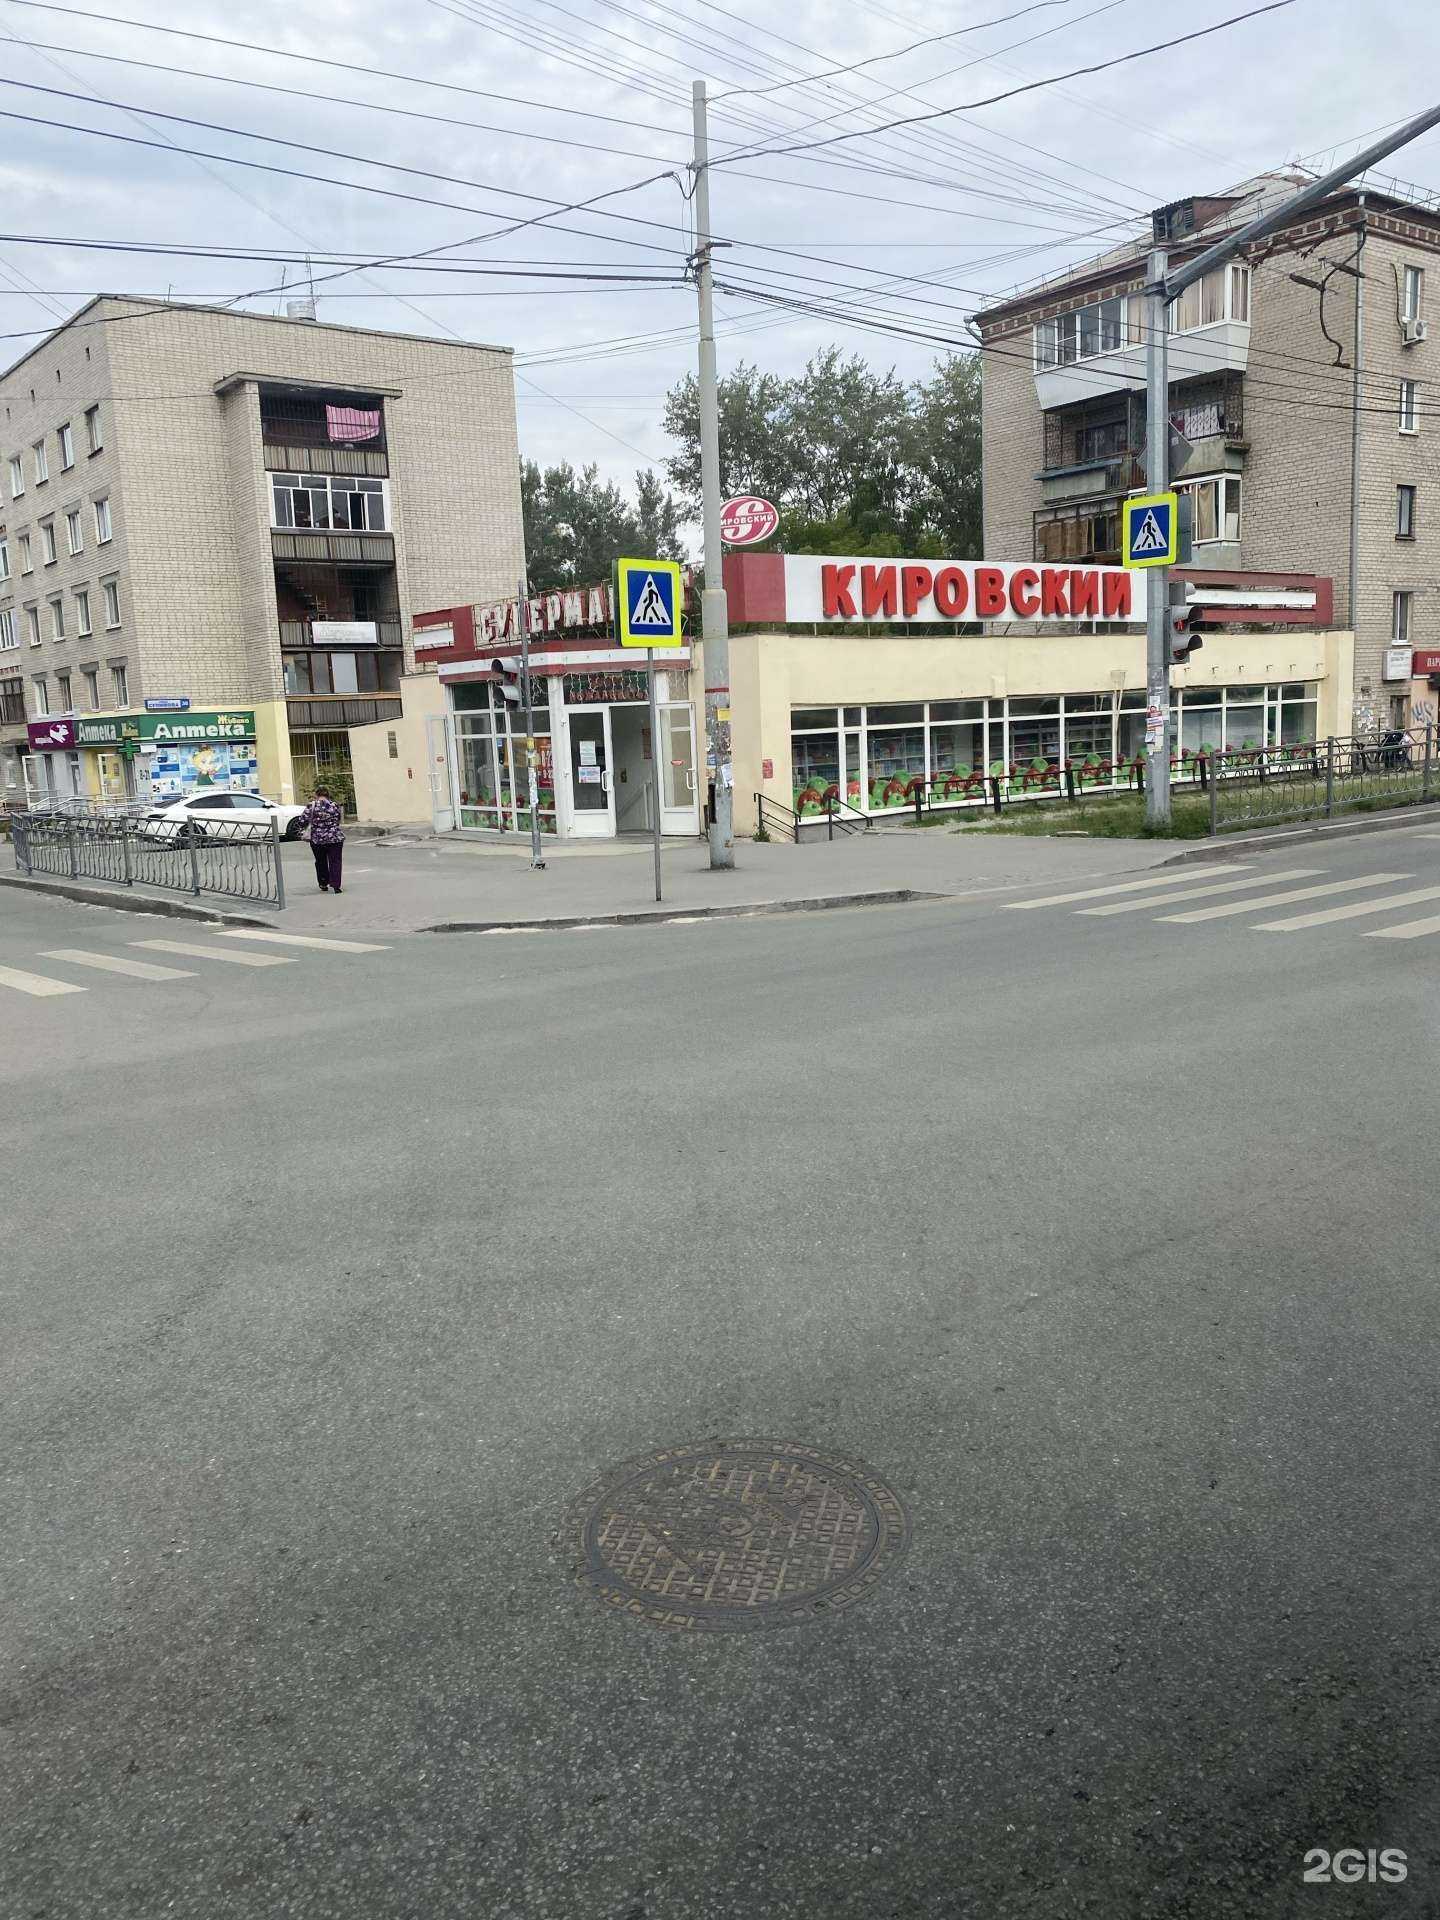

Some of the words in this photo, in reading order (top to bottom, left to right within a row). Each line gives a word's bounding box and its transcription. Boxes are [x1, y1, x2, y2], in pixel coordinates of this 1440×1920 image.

[720, 514, 774, 526] ИРОВСКИЙ
[79, 722, 117, 742] Аптека
[153, 723, 246, 739] Аптека
